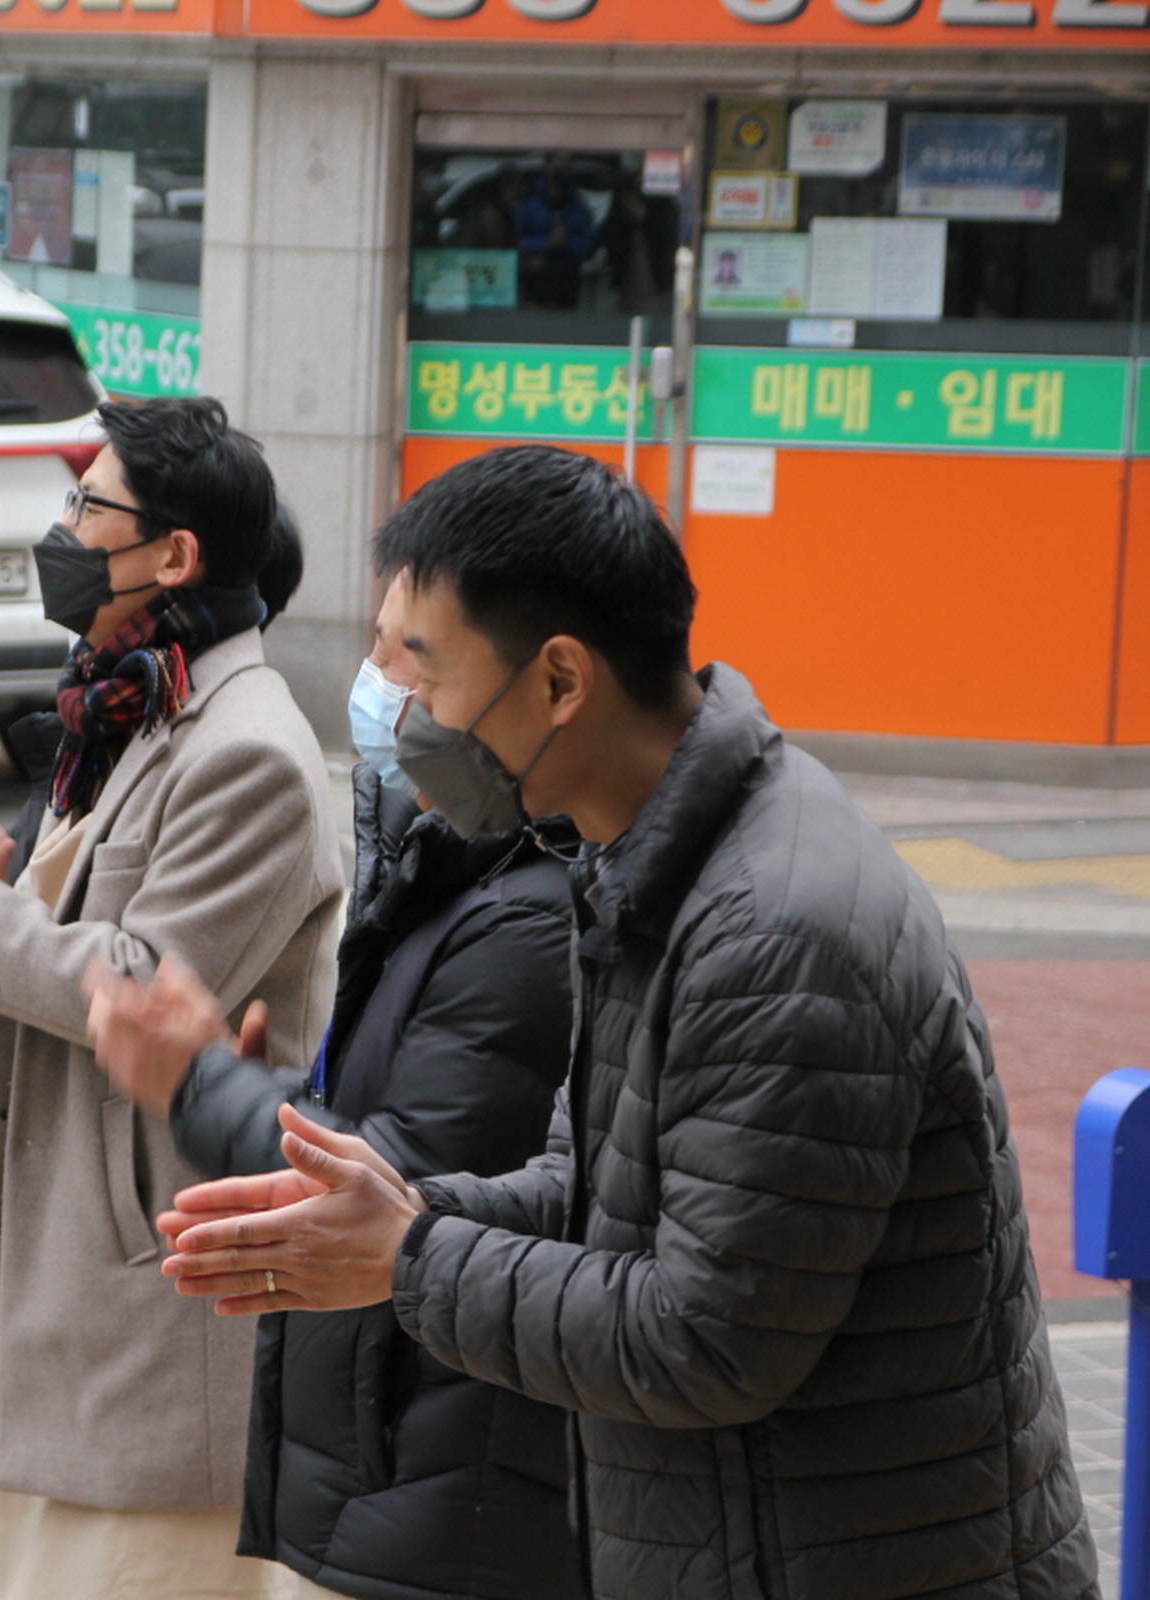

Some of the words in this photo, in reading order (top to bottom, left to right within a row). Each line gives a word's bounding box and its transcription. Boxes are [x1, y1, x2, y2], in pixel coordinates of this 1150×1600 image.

[419, 360, 648, 425] 명성부동산
[752, 363, 872, 434] 매매
[938, 367, 1065, 442] 임대
